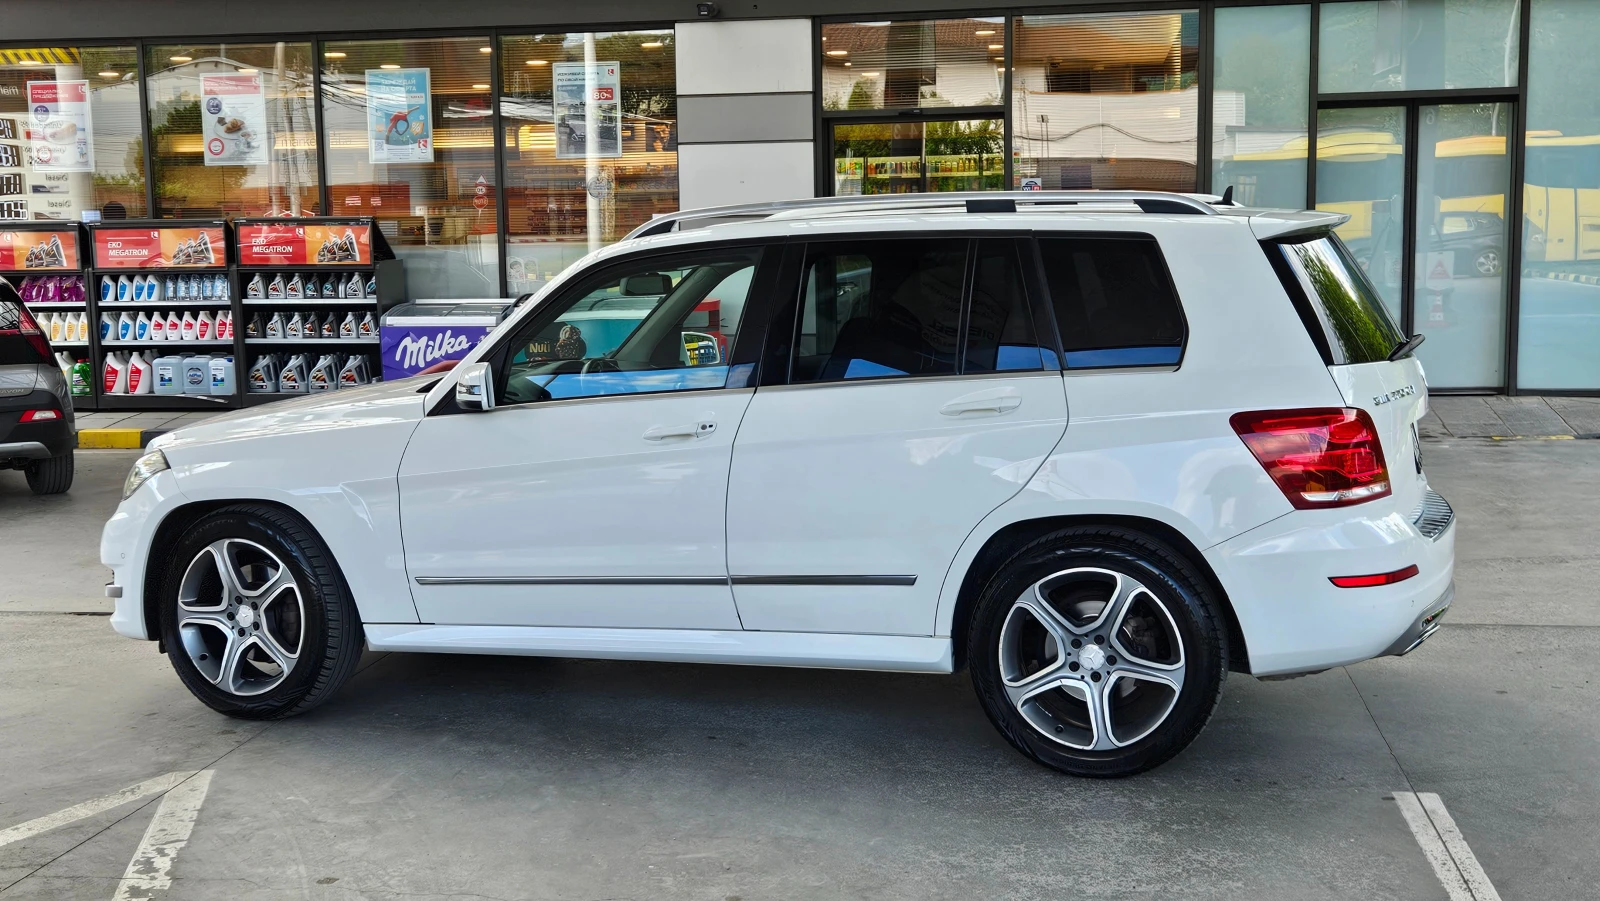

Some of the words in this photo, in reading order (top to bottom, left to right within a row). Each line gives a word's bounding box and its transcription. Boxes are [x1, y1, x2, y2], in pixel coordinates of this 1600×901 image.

[593, 91, 612, 100] 80%
[107, 241, 122, 249] EKO
[252, 245, 293, 253] MEGATRON
[395, 329, 471, 369] Milka
